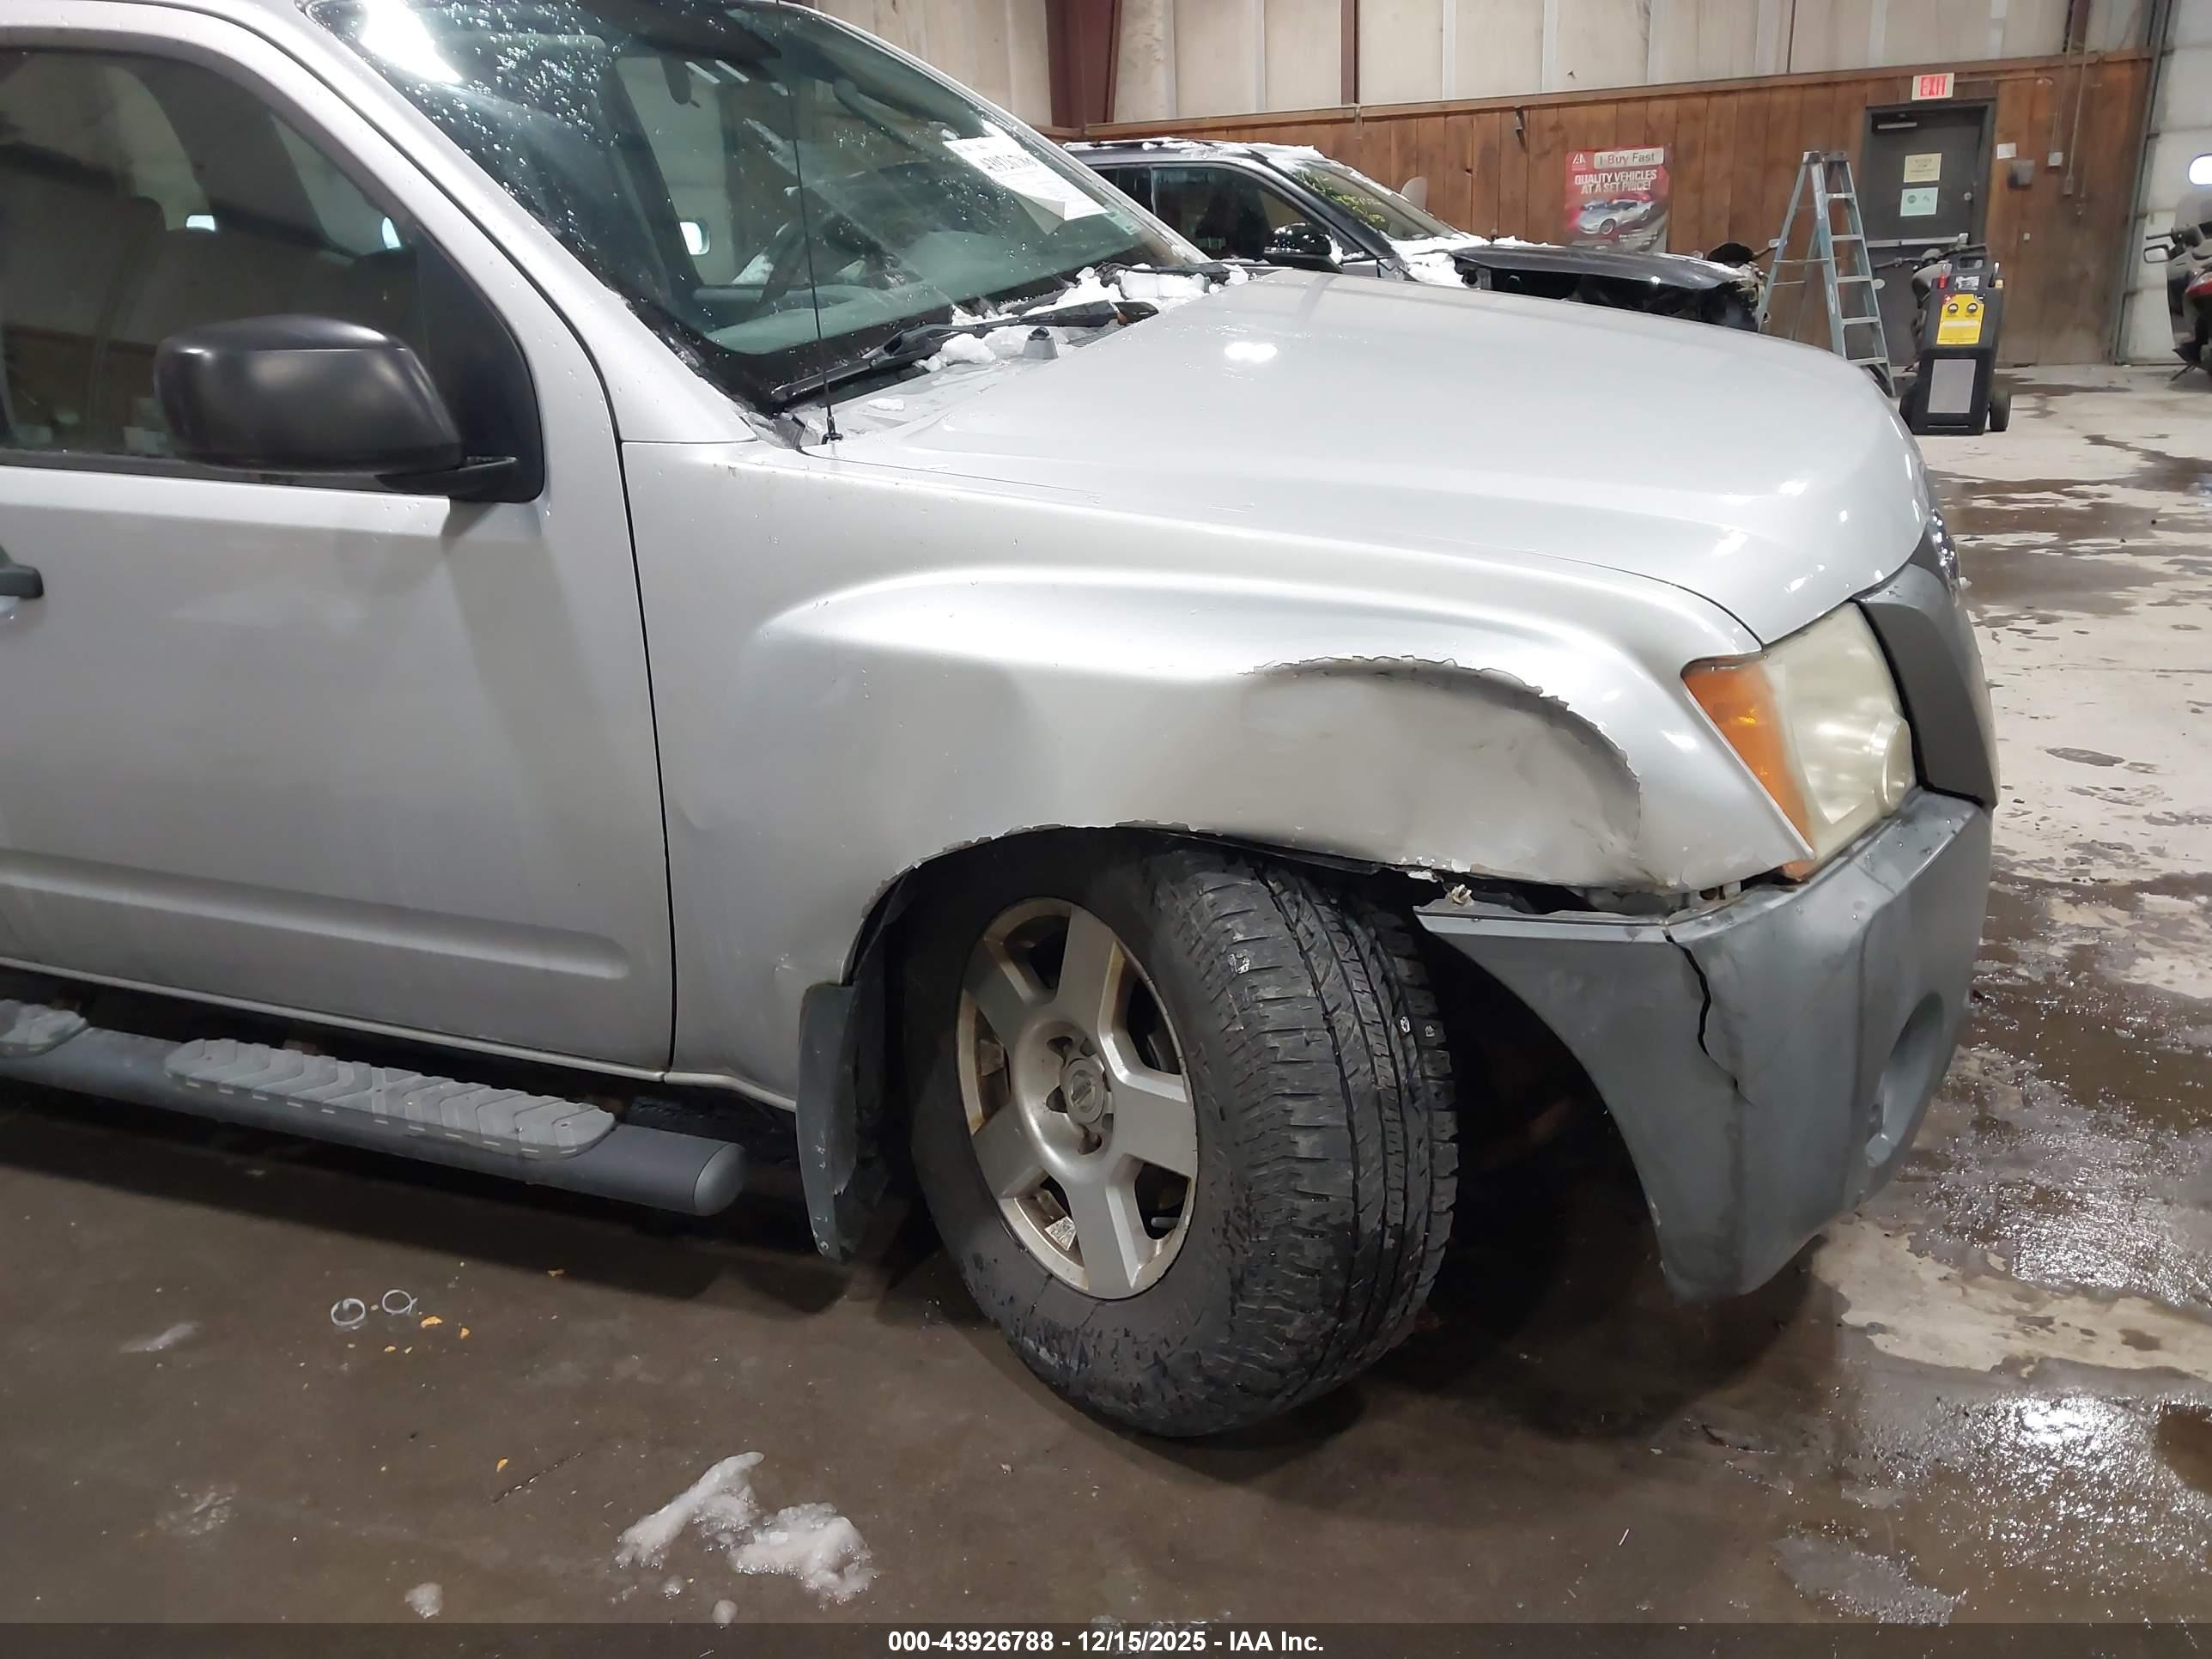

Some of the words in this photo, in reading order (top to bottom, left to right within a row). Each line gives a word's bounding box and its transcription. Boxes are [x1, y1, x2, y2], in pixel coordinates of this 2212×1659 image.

[1920, 75, 1947, 97] EXIT
[1607, 154, 1629, 166] Buy
[1632, 152, 1655, 162] Fast
[1575, 173, 1613, 185] QUALITY
[1613, 169, 1657, 181] VEHICLES
[1581, 183, 1595, 194] AT
[1595, 182, 1602, 193] A
[1603, 181, 1620, 193] SET
